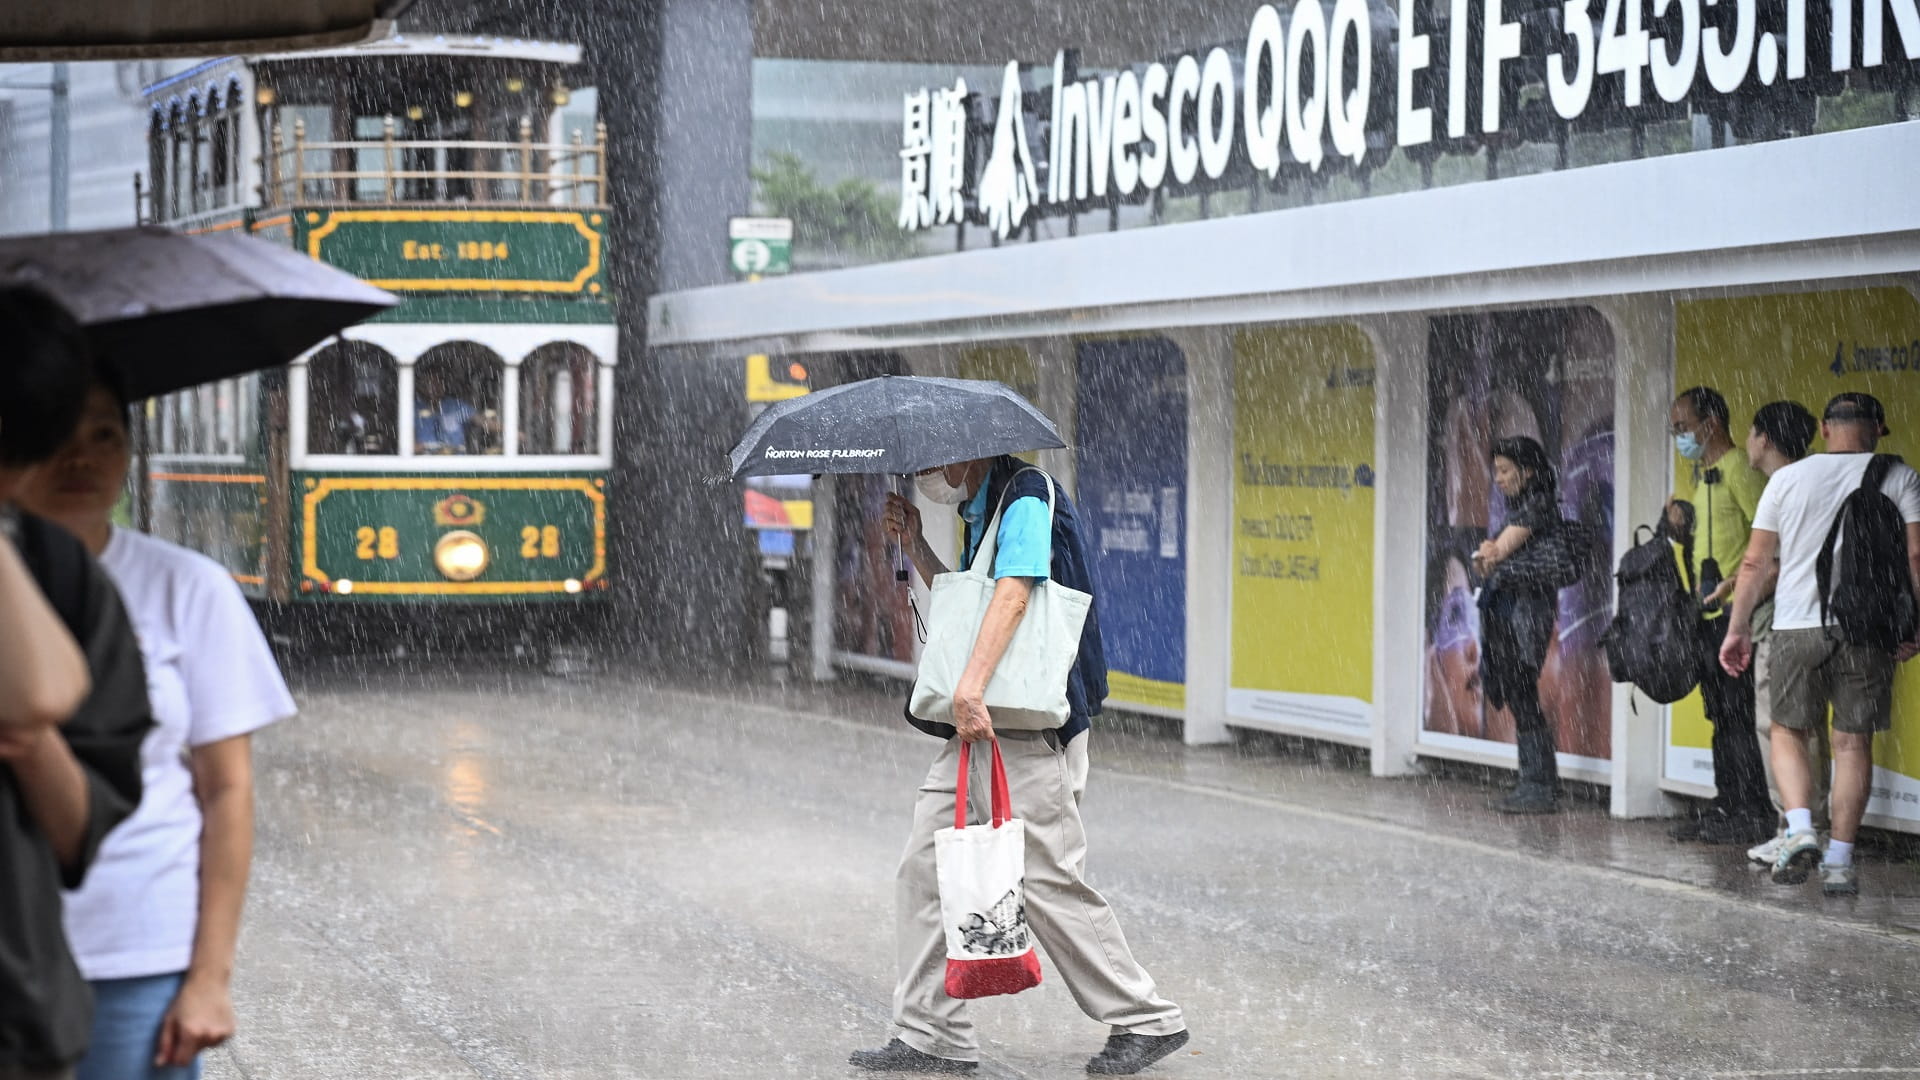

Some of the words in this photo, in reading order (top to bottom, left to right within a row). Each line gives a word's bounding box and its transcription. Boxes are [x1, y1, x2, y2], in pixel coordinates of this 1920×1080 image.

[1047, 47, 1235, 204] Invesco
[1243, 0, 1372, 179] QQQ
[899, 77, 967, 231] 景順
[765, 445, 805, 459] NORTON
[806, 449, 831, 459] ROSE
[831, 448, 885, 459] FULBRIGHT
[356, 526, 398, 560] 28
[520, 524, 560, 558] 28
